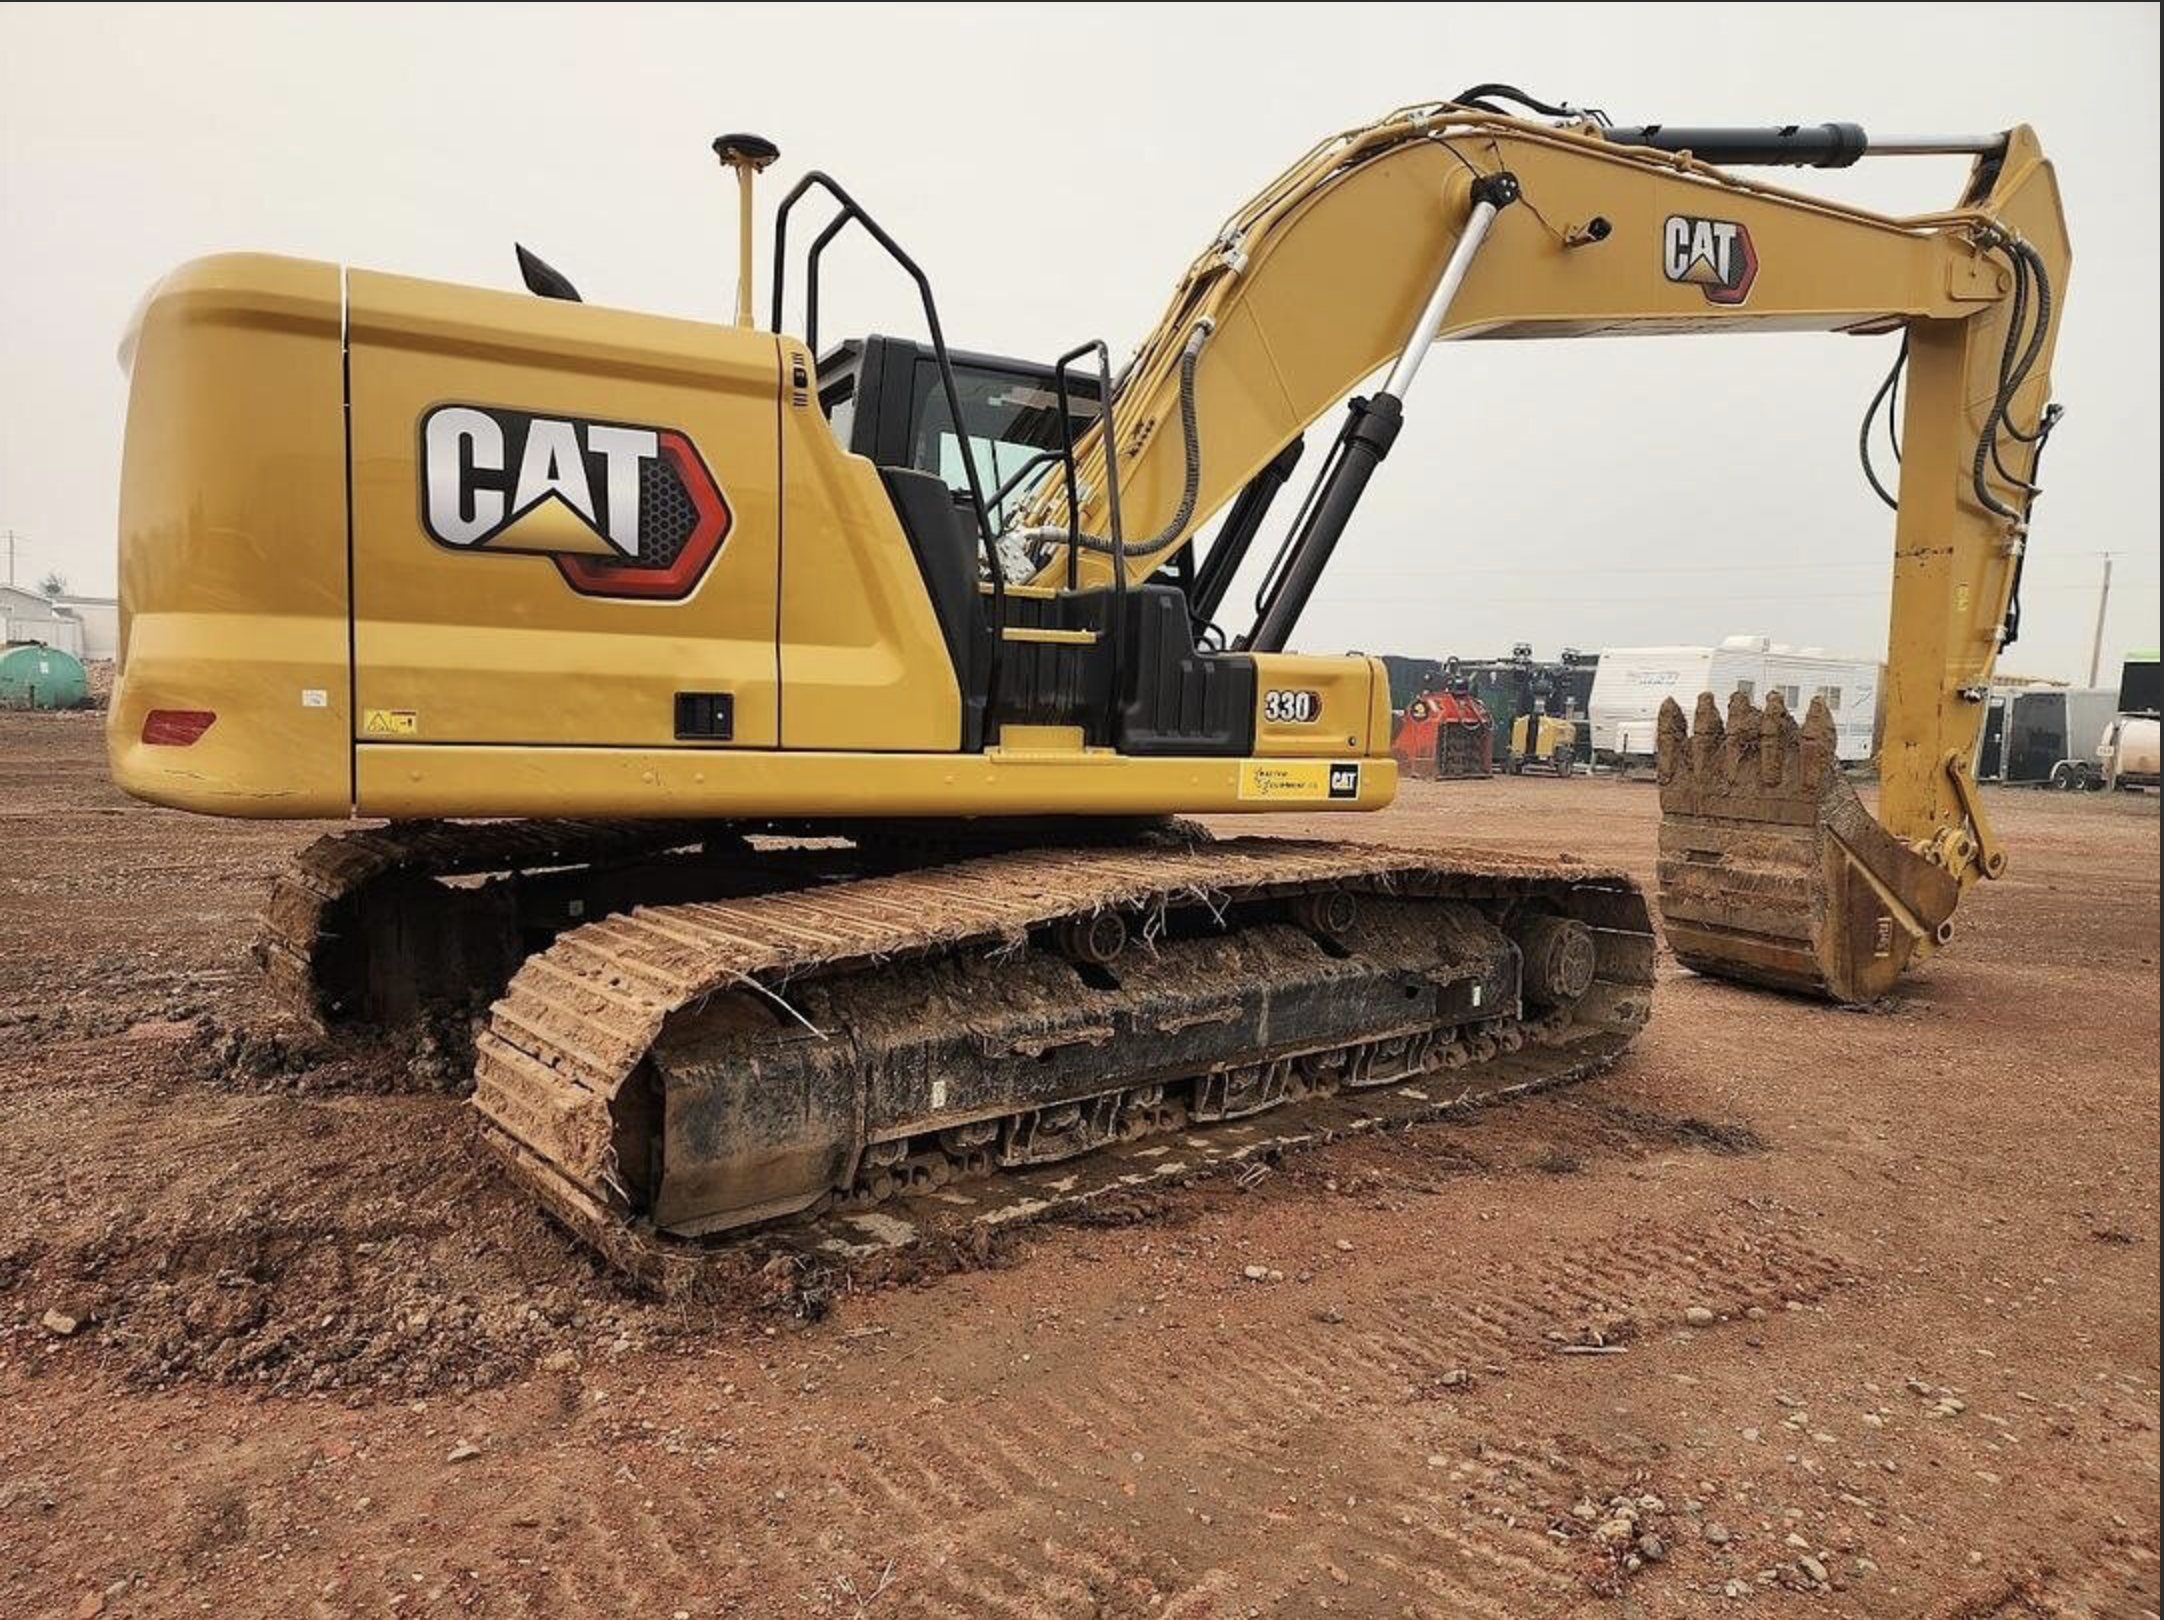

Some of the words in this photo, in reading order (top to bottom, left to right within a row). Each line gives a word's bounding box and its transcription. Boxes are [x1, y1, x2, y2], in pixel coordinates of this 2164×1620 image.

[1664, 216, 1737, 285] CAT
[425, 406, 659, 557] CAT
[1265, 691, 1309, 721] 330
[1331, 771, 1356, 790] CAT
